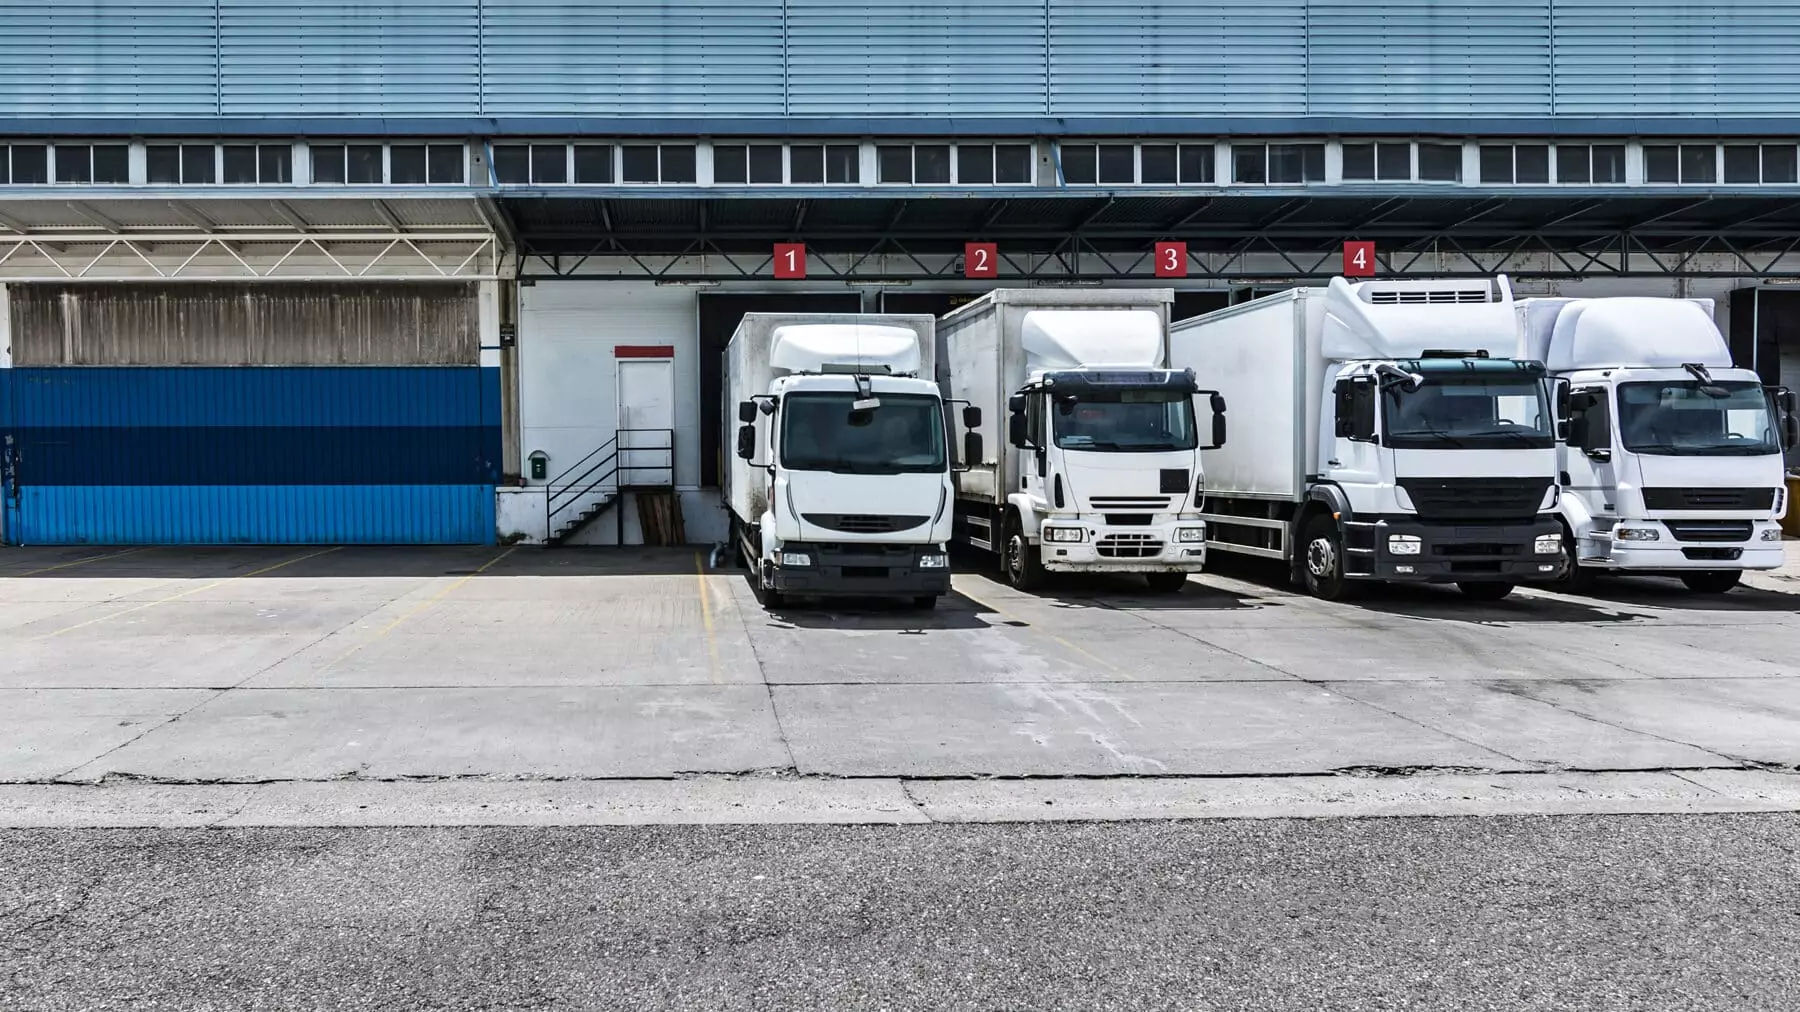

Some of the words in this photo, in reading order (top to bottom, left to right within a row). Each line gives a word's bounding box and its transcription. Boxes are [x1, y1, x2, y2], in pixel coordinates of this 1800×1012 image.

[784, 249, 796, 272] 1
[974, 249, 989, 271] 2
[1164, 248, 1178, 271] 3
[1352, 247, 1367, 269] 4
